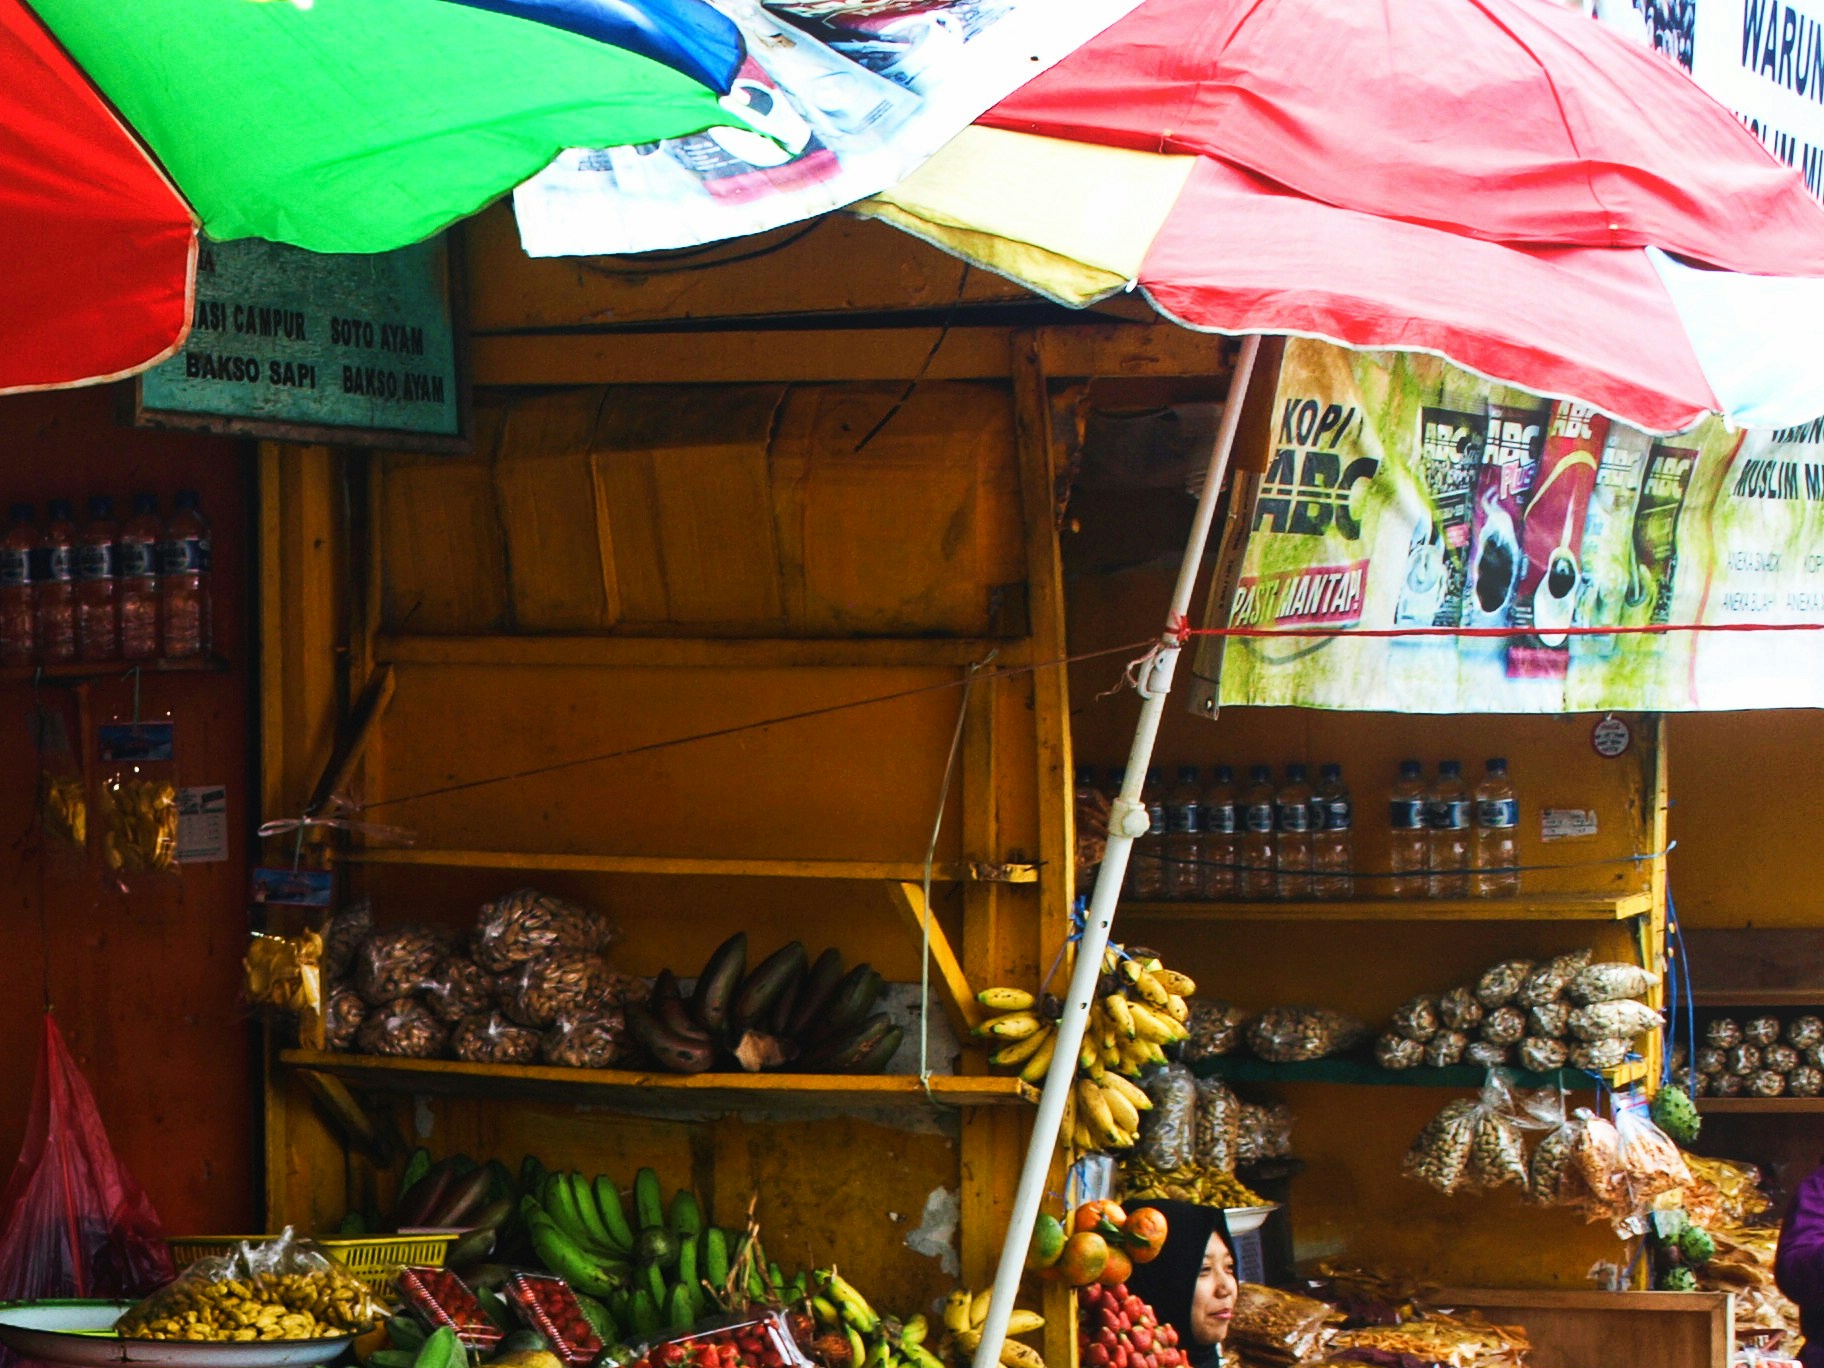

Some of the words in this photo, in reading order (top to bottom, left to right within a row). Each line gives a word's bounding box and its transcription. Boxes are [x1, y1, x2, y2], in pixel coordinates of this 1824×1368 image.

[193, 301, 225, 332] ASI
[233, 304, 306, 341] CAMPUR
[331, 317, 374, 348] SOTO
[380, 326, 424, 356] AYAM
[186, 352, 260, 384] BAKSO
[269, 361, 316, 390] SAPI
[343, 366, 398, 398] BAKSO
[403, 372, 445, 404] AYAM
[1279, 398, 1356, 449] KOPI
[1424, 422, 1469, 464] ABC
[1482, 418, 1541, 467] ABC
[1551, 399, 1598, 441] ABC
[1251, 448, 1380, 541] ABC
[1644, 456, 1693, 499] ABC
[1732, 459, 1799, 500] MUSLIM
[1276, 569, 1363, 620] MANTAP!
